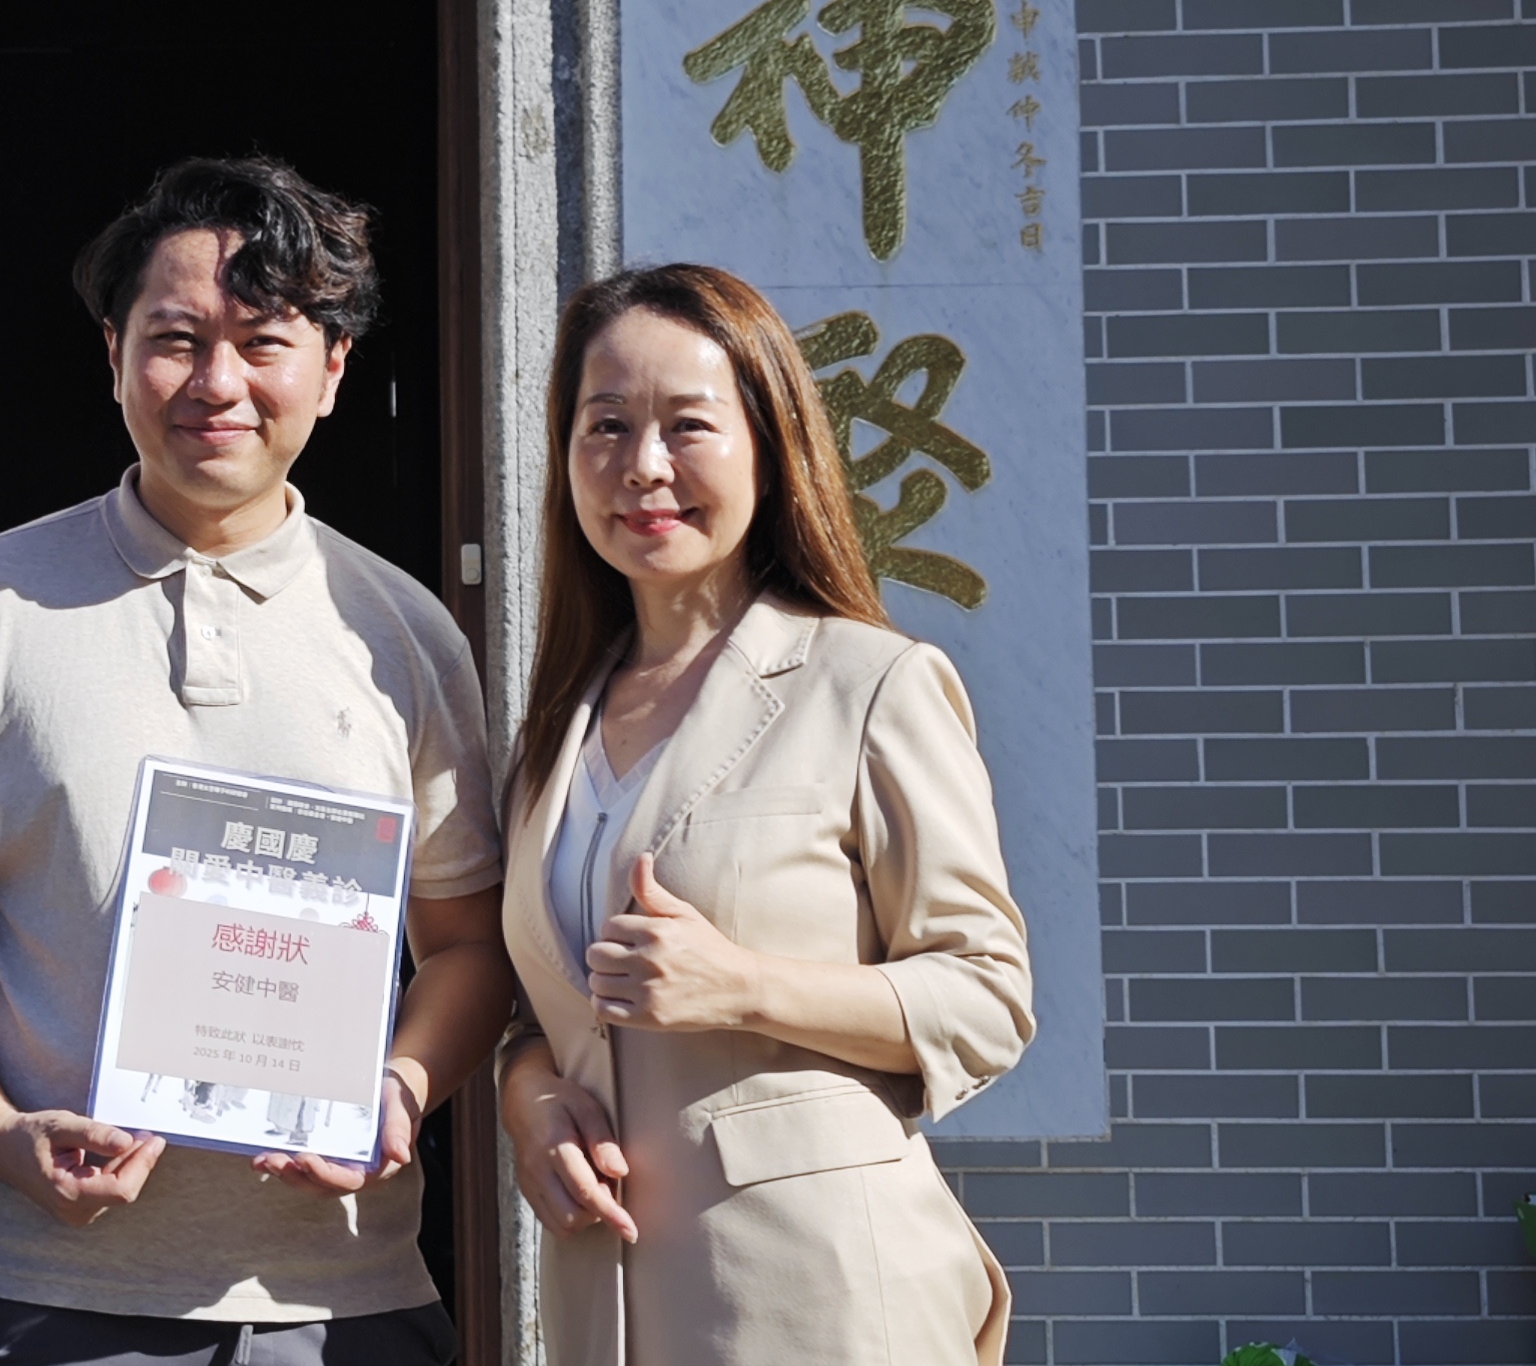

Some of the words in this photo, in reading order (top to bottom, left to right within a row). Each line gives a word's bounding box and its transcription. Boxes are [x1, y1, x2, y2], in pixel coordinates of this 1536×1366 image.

[220, 821, 320, 864] 慶國慶
[211, 923, 310, 965] 感謝狀
[211, 970, 300, 1003] 安健中醫
